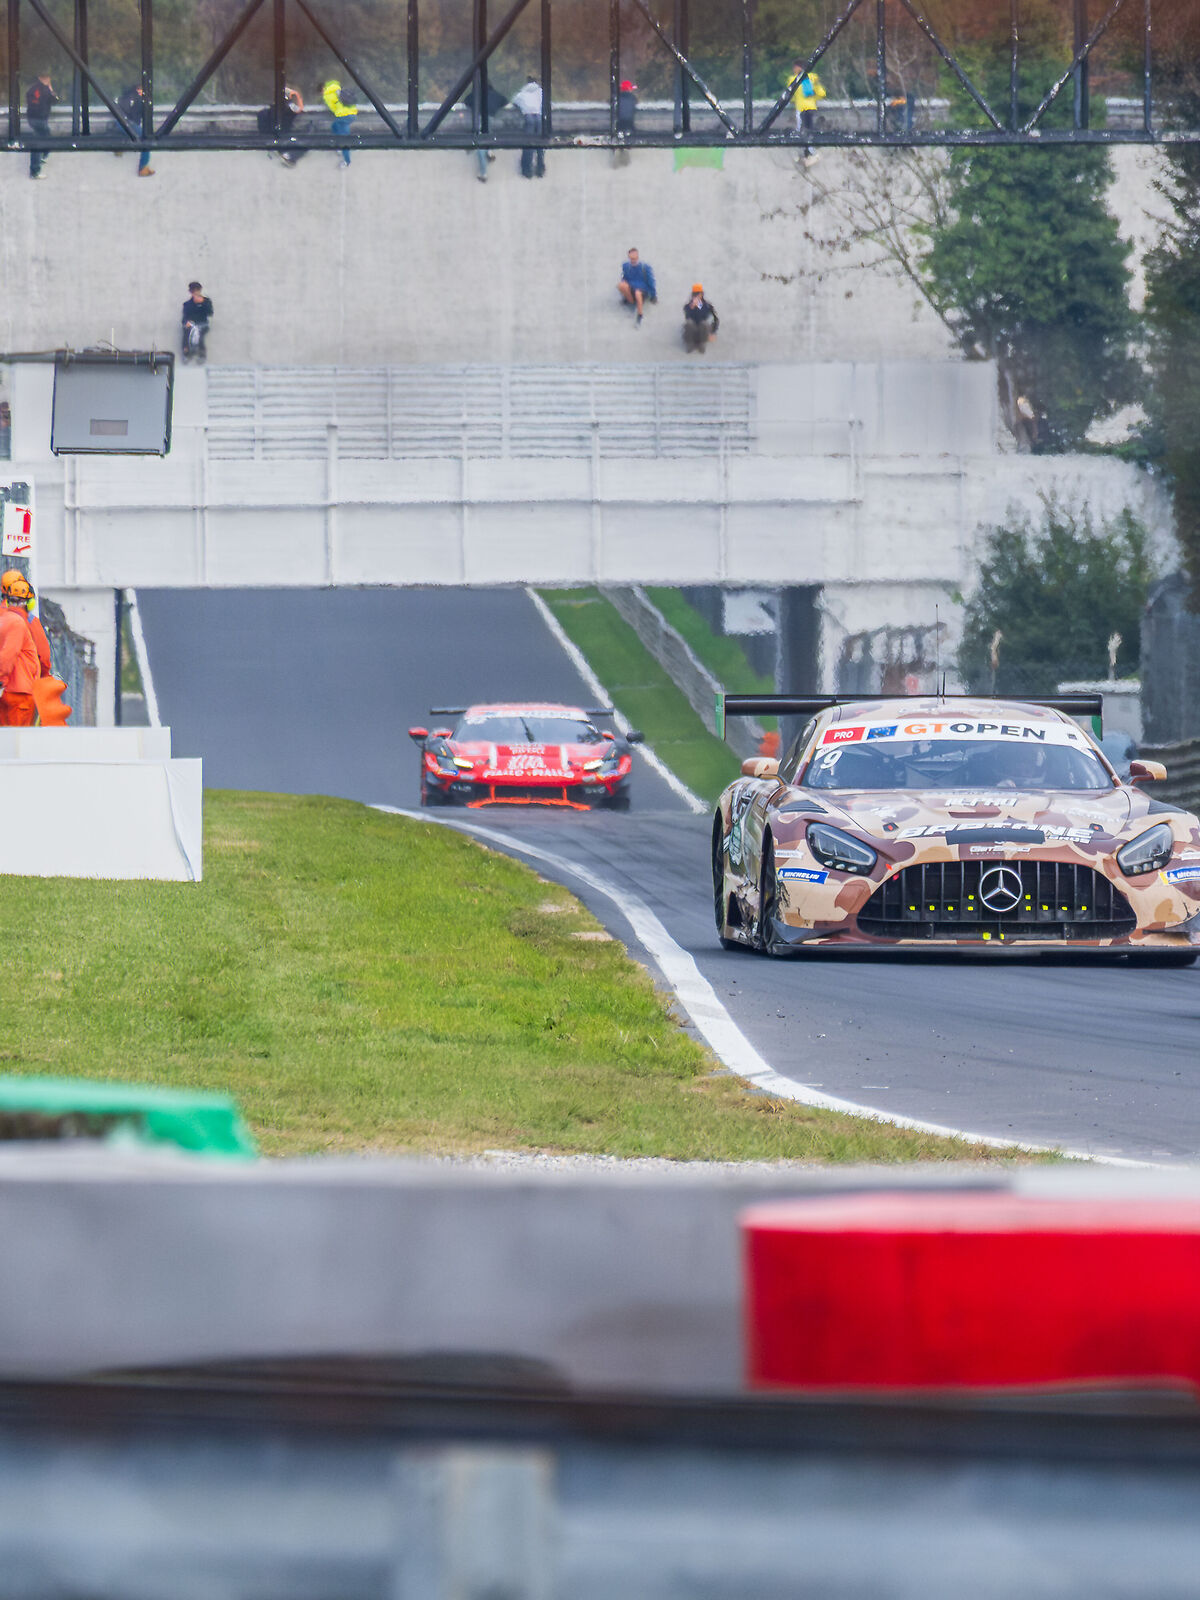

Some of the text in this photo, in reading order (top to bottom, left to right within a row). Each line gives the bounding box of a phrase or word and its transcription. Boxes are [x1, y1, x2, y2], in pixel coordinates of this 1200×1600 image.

[7, 535, 31, 543] FIRE
[833, 731, 854, 740] PRO
[820, 750, 842, 769] 9
[784, 871, 820, 880] MICHELIN
